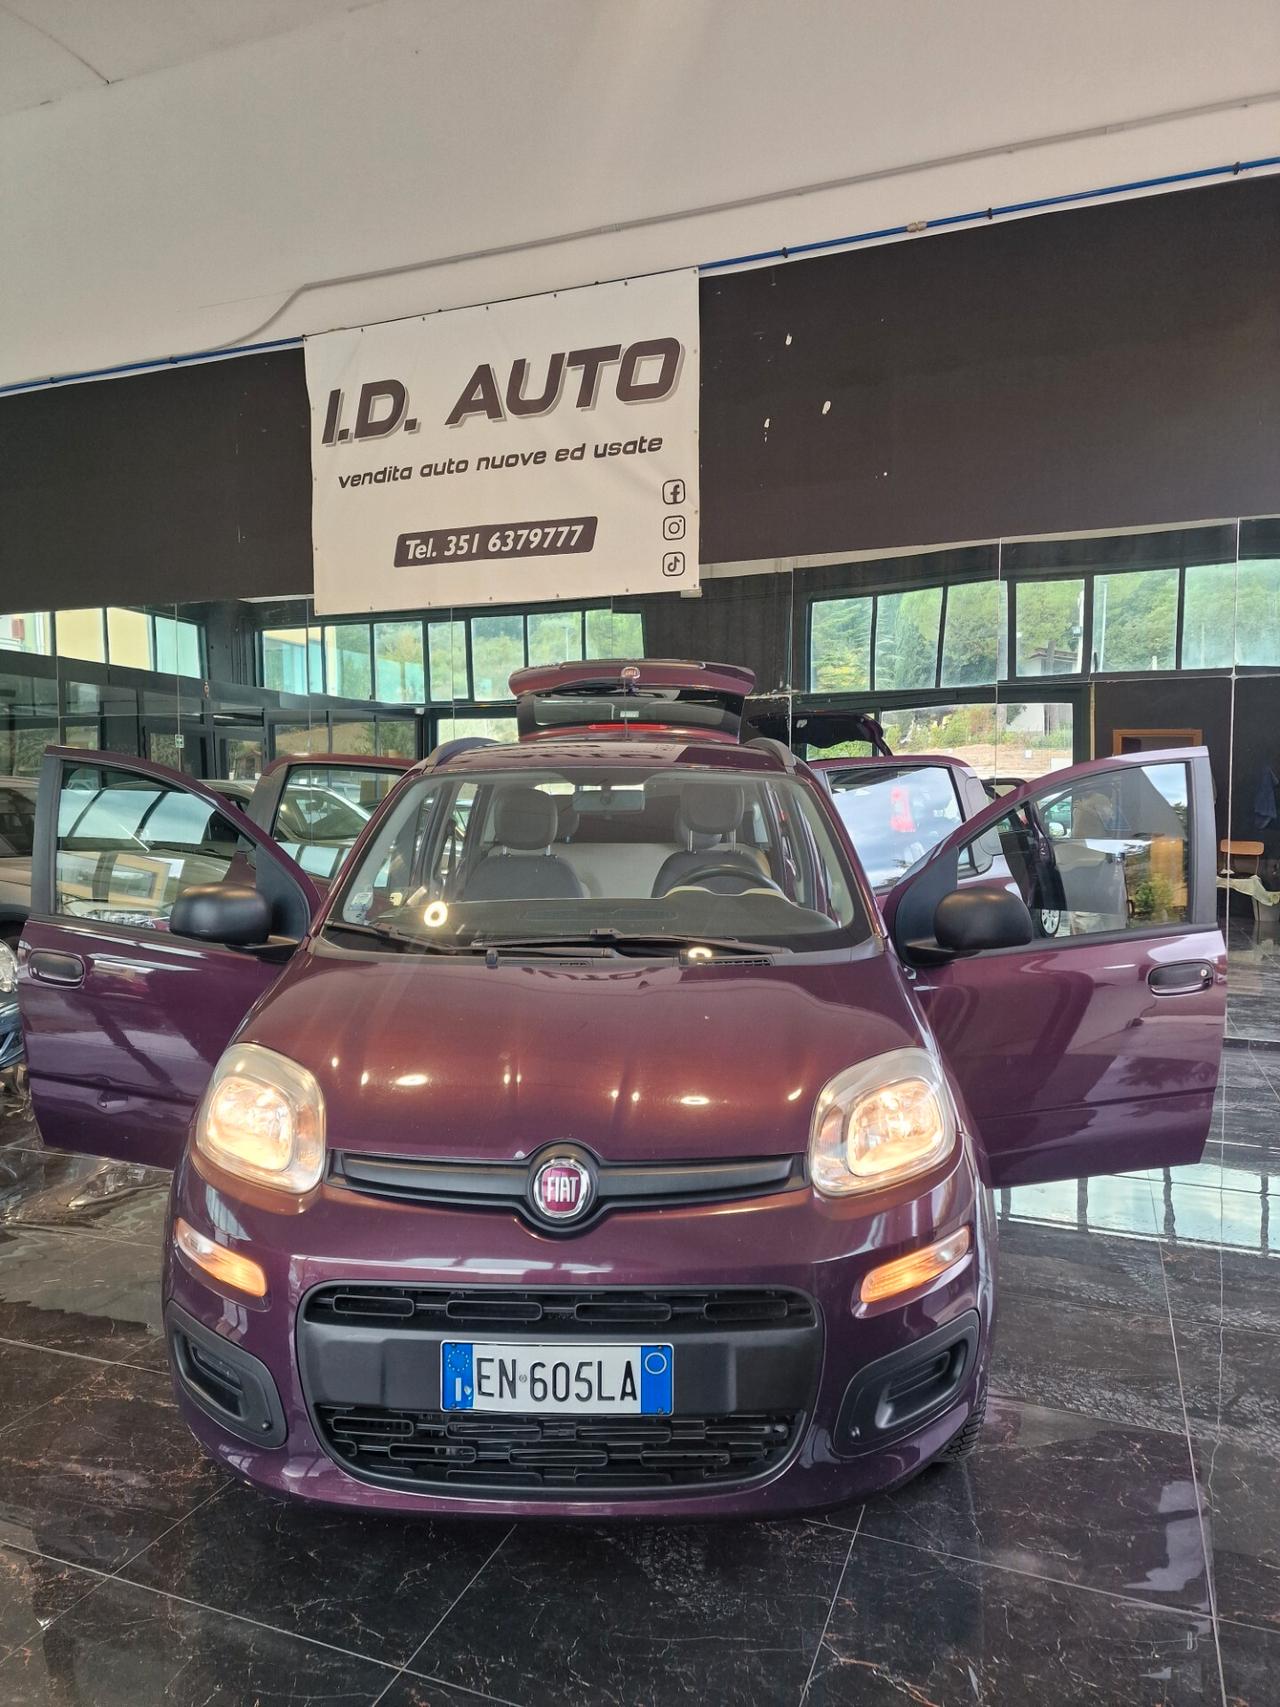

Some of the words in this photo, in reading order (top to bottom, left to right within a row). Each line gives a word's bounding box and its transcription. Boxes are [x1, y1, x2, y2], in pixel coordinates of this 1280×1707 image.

[321, 379, 419, 446] I.D.
[444, 337, 683, 427] AUTO
[338, 464, 413, 489] vendita
[419, 457, 469, 478] auto
[476, 448, 547, 471] nuove
[554, 442, 586, 463] ed
[593, 435, 663, 459] usate
[404, 538, 438, 561] Tel.
[443, 532, 479, 556] 351
[486, 524, 585, 553] 6379777
[546, 1176, 579, 1203] FIAT
